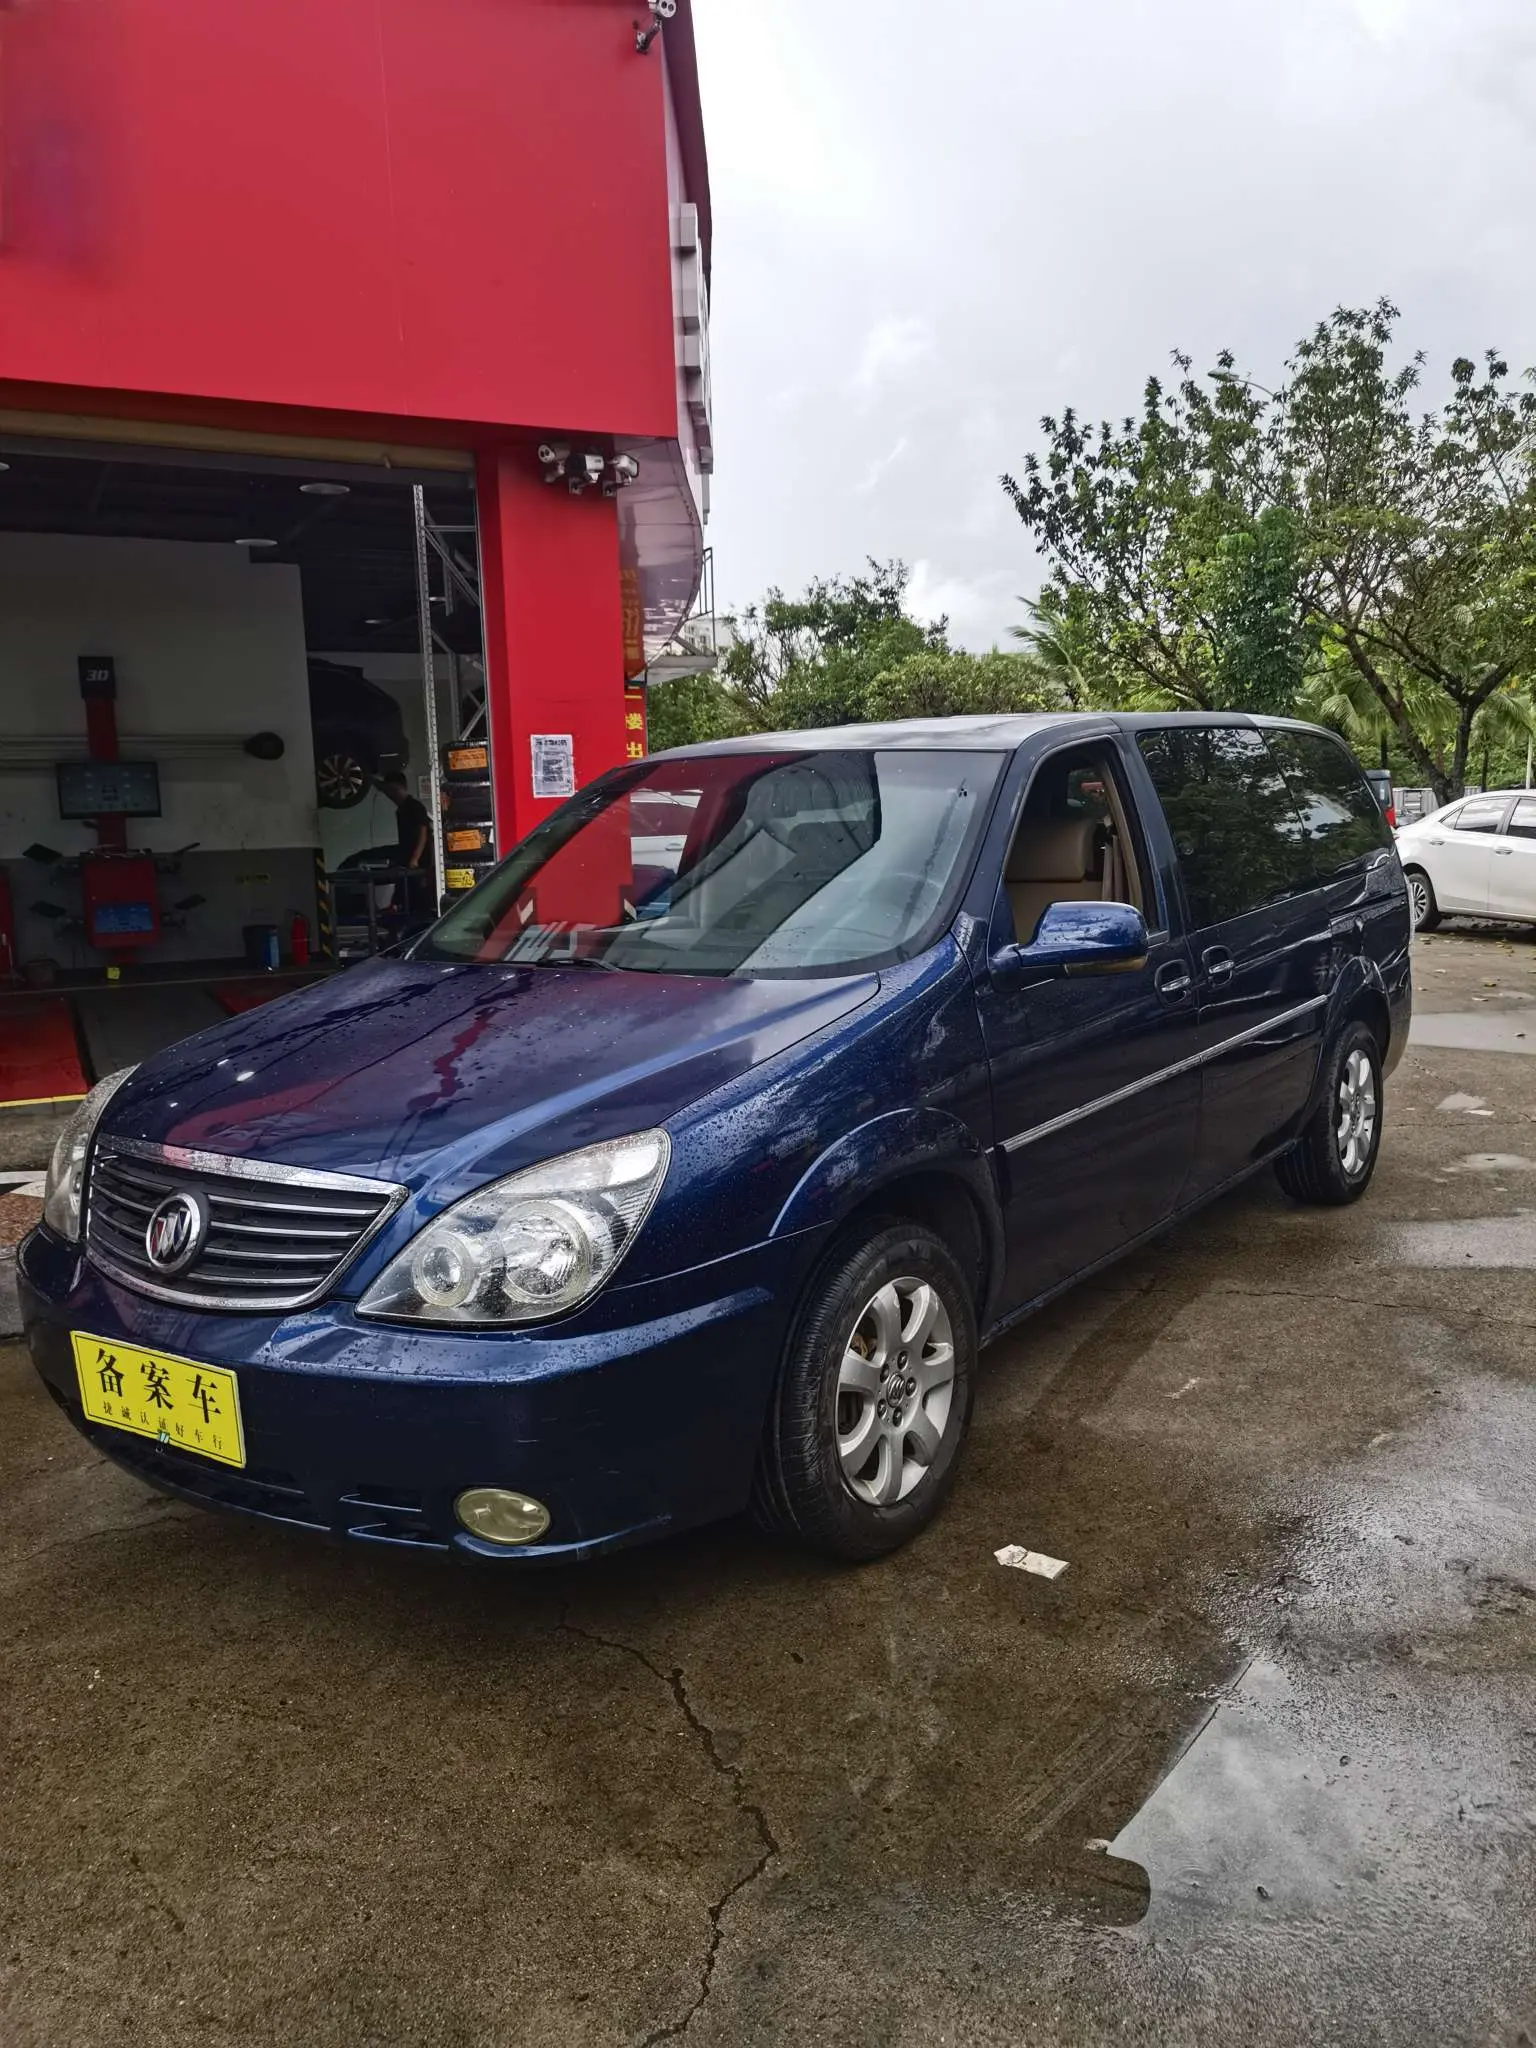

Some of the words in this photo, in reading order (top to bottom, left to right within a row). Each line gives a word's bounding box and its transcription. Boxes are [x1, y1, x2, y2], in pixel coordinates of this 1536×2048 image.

[86, 669, 109, 681] 3D
[96, 1348, 221, 1423] 备案车
